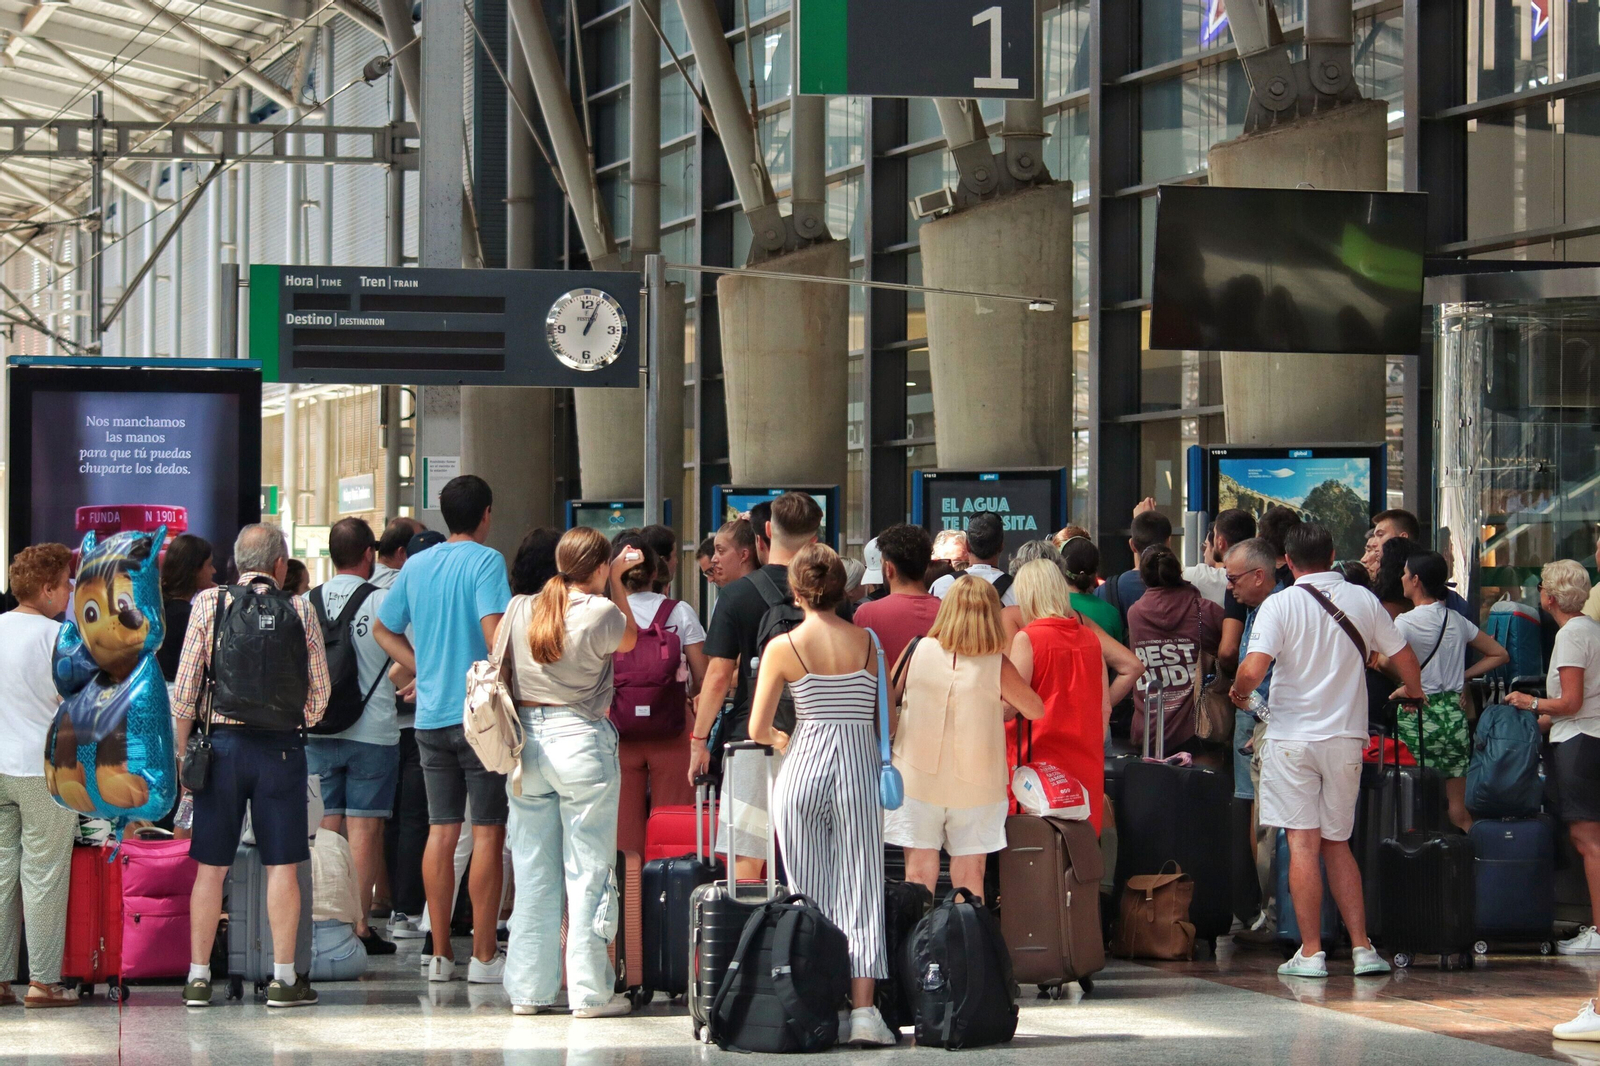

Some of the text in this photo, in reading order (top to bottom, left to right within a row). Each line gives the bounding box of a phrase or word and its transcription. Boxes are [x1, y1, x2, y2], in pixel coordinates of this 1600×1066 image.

[972, 6, 1019, 89] 1
[285, 275, 342, 287] Hora TIME
[360, 276, 419, 288] Tren TRAIN
[581, 300, 594, 310] 12
[286, 313, 385, 326] Destino DESTINATION
[557, 324, 566, 334] 9
[607, 325, 616, 335] 3
[582, 350, 591, 360] 6
[86, 415, 186, 428] Nos manchamos
[105, 431, 166, 443] las manos
[79, 447, 192, 461] para que tú puedas
[79, 463, 191, 476] chuparte los dedos.
[942, 497, 1010, 513] EL AGUA
[156, 511, 177, 523] 1901
[942, 515, 1037, 531] TE NSITA
[1135, 643, 1195, 668] BEST
